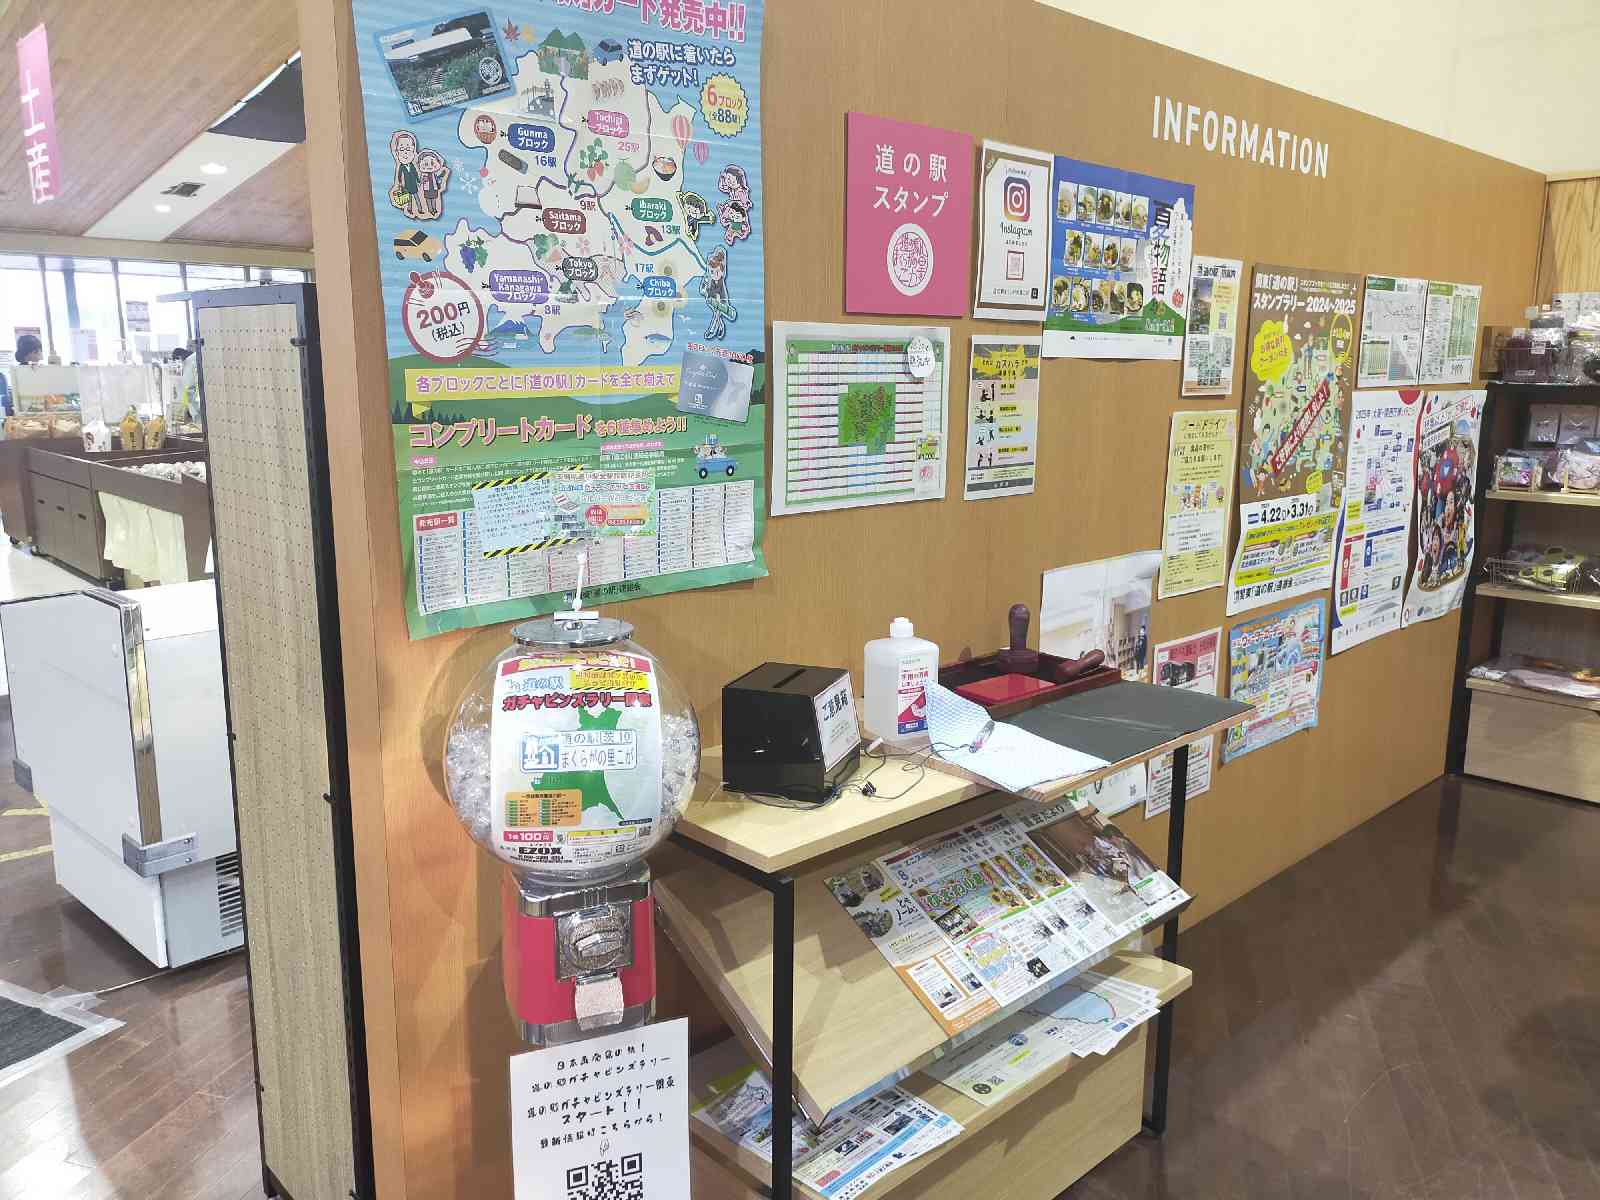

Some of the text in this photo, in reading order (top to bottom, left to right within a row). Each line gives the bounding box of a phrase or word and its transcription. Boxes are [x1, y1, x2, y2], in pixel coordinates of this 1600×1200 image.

[627, 39, 736, 66] 道の駅に着いたら
[629, 64, 699, 87] まずゲット!
[517, 127, 548, 139] Gunma
[1152, 95, 1329, 179] INFORMATION
[518, 137, 549, 150] ブロック
[535, 155, 557, 168] 16駅
[874, 143, 948, 183] 道の駅
[639, 200, 667, 211] Ibaraki
[873, 185, 949, 217] スタンプ
[549, 212, 582, 223] Saitama
[639, 210, 667, 220] ブロック
[550, 221, 581, 232] ブロック
[1000, 222, 1033, 240] Instagram
[569, 260, 594, 271] Tokyo
[567, 267, 596, 278] ブロック
[649, 280, 671, 289] Chiba
[646, 287, 673, 297] ブロック
[416, 301, 471, 330] 200円
[432, 321, 465, 342] (税込)
[1261, 502, 1309, 525] 4.22 3.31
[822, 688, 849, 722] ご意見箱
